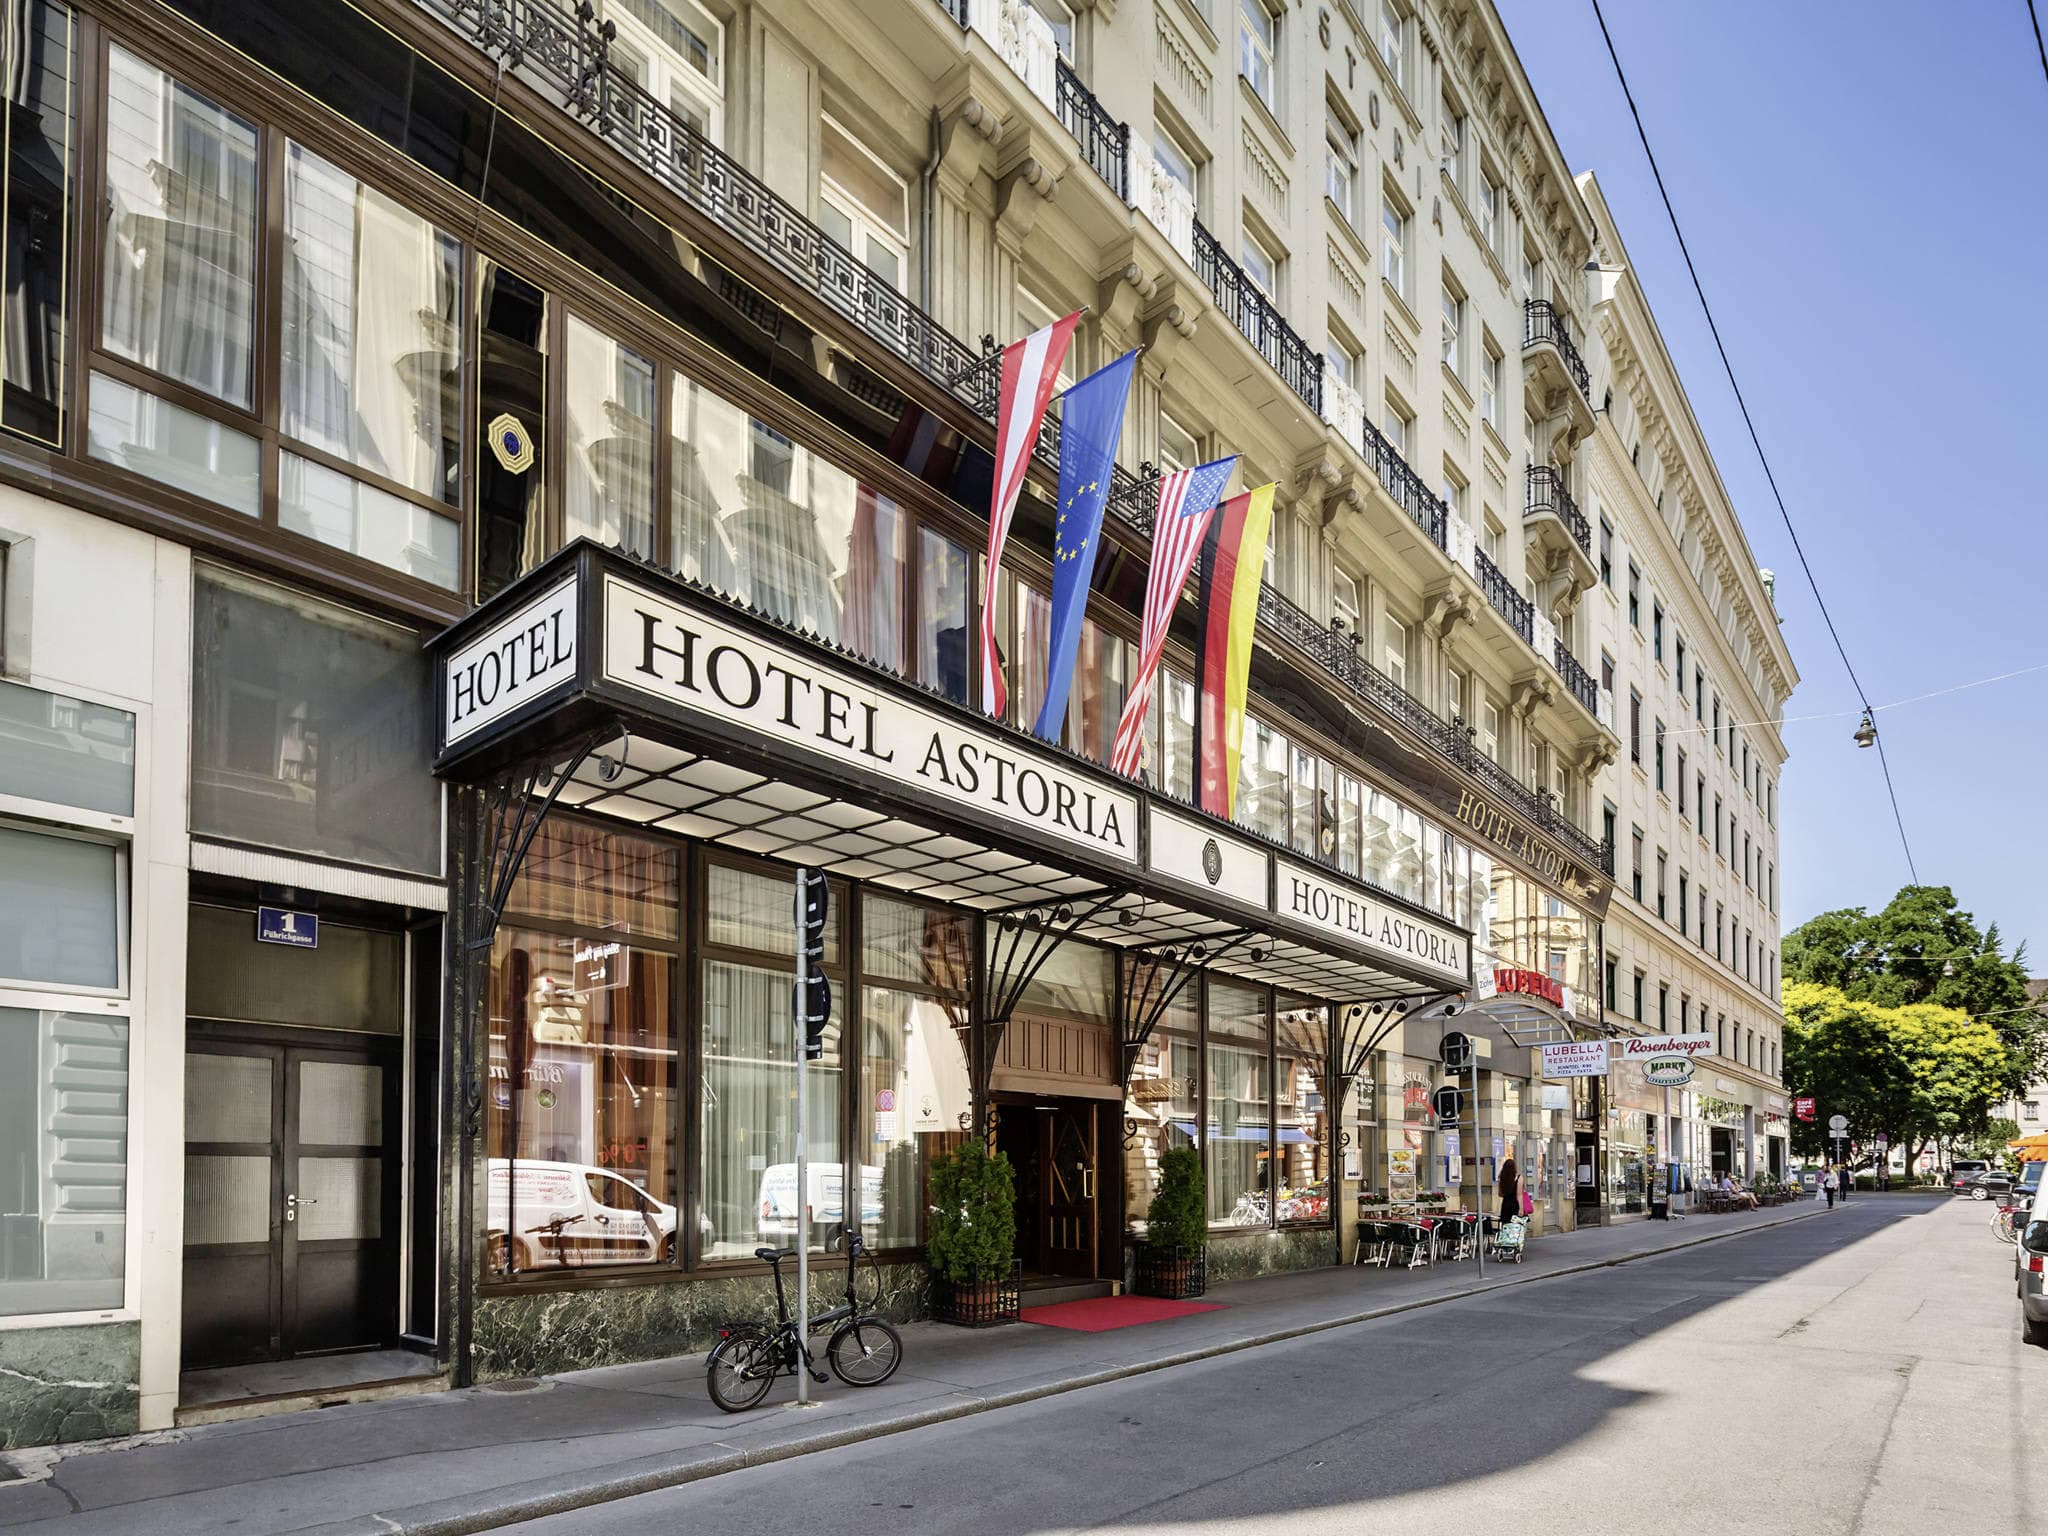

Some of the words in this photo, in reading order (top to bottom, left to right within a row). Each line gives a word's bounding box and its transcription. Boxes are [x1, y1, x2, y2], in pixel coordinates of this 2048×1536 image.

[1297, 0, 1444, 238] STORIA
[451, 608, 573, 724] HOTEL
[634, 608, 894, 762] HOTEL
[917, 731, 1126, 849] ASTORIA
[1455, 788, 1514, 852] HOTEL
[1517, 834, 1577, 891] ASTORIA
[263, 929, 313, 943] Führichgasse
[280, 912, 297, 933] 1
[1291, 877, 1373, 938] HOTEL
[1380, 914, 1460, 970] ASTORIA
[1493, 969, 1564, 1009] LUBELLA
[1544, 1043, 1604, 1056] LUBELLA
[1547, 1055, 1601, 1064] RESTAURANT
[1625, 1038, 1712, 1055] Rosenberger
[1651, 1062, 1686, 1074] MARKT
